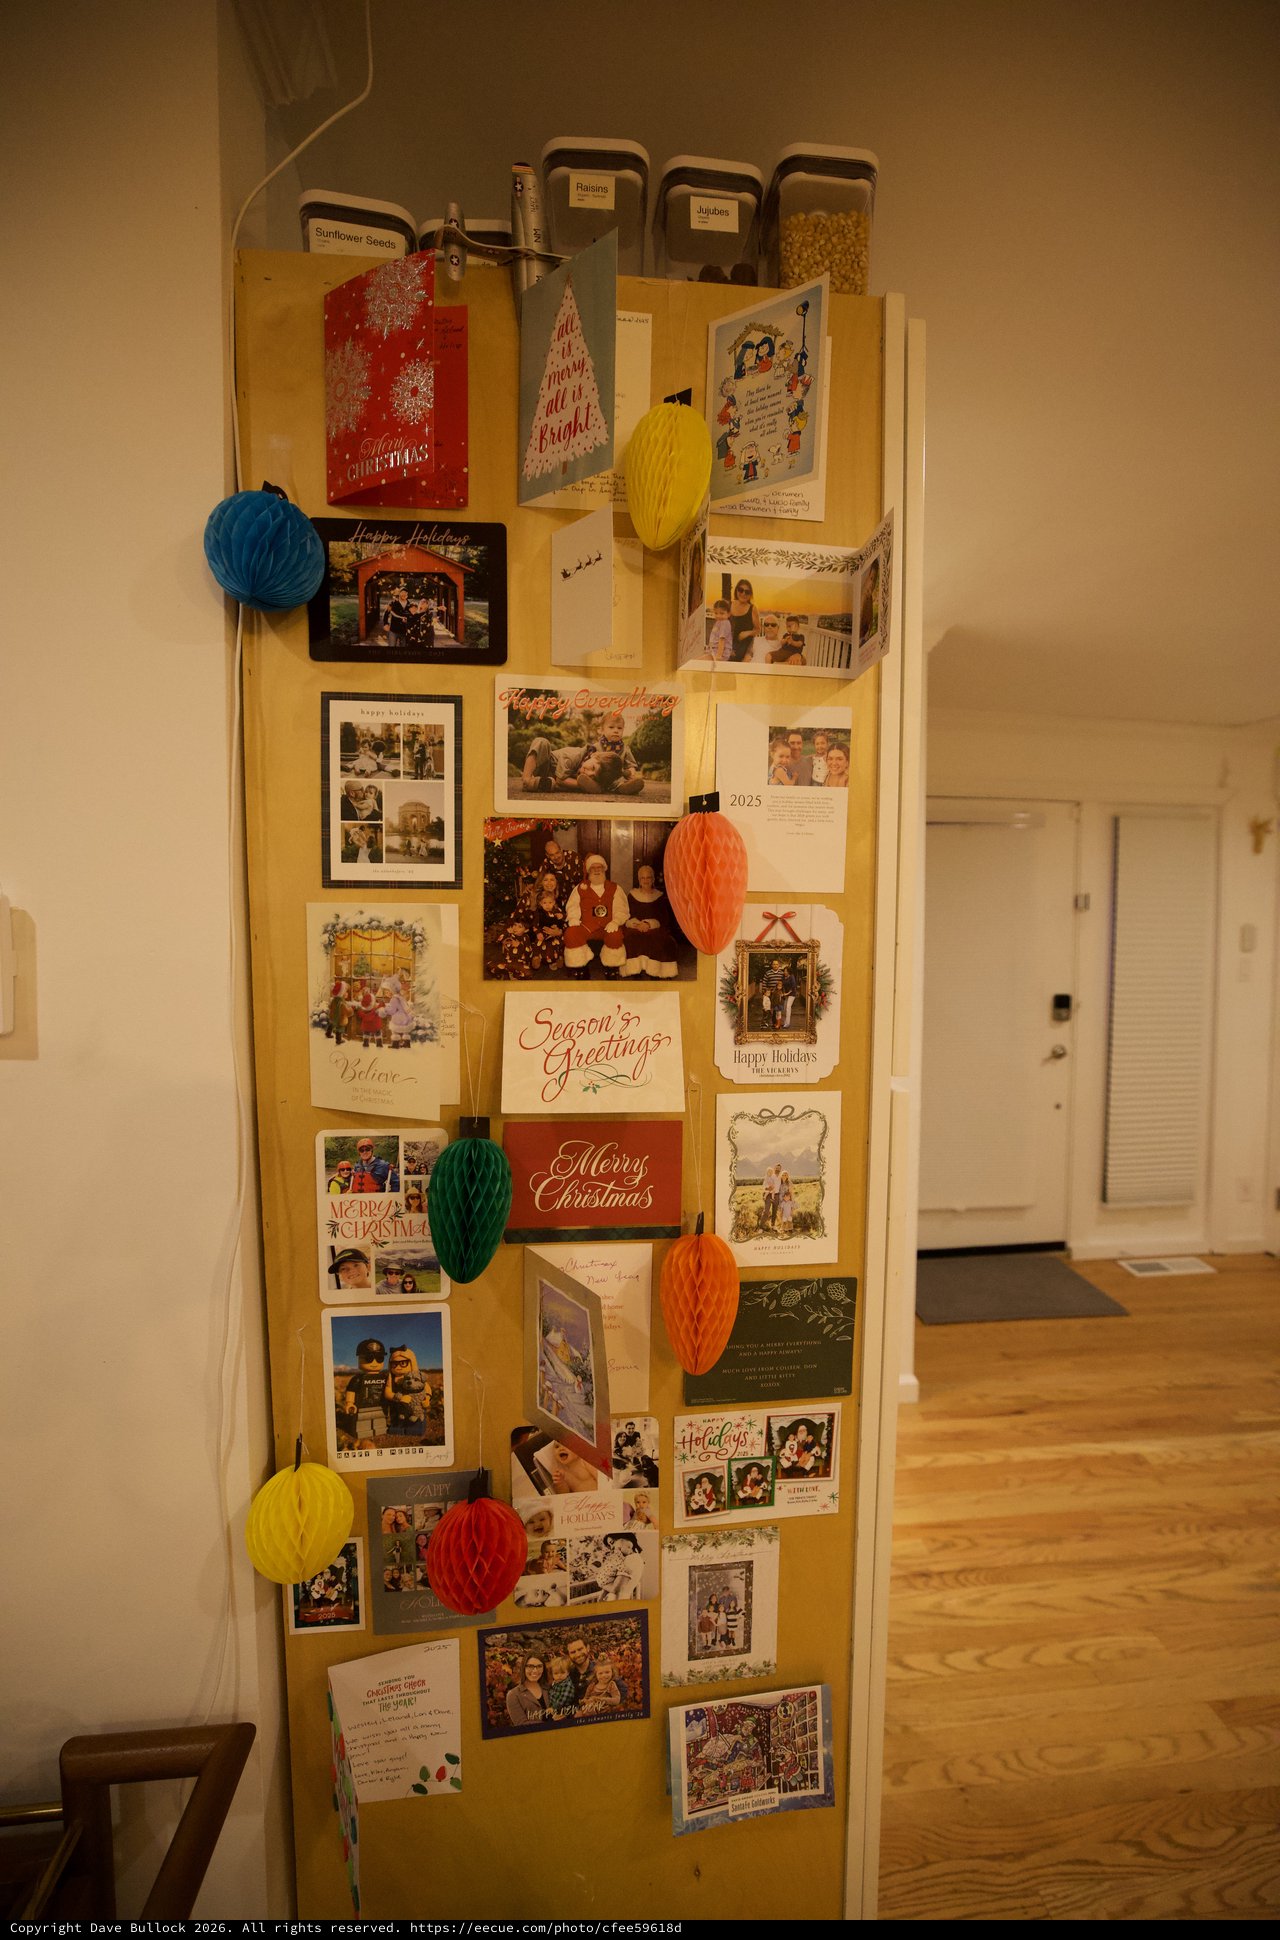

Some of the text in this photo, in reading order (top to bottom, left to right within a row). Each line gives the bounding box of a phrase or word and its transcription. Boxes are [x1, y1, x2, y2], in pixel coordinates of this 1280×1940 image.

[576, 182, 609, 194] Raisins
[696, 205, 730, 217] Jujubes
[315, 228, 396, 250] Sunflower Seeds
[557, 314, 576, 341] all
[561, 340, 572, 360] is
[548, 357, 586, 390] merry
[546, 383, 584, 418] all is
[539, 402, 591, 454] Bright
[359, 432, 417, 460] Merry
[347, 444, 429, 482] CHRISTMAS
[348, 521, 470, 550] Happy Holidays
[360, 708, 425, 717] happy holidays
[498, 686, 681, 720] Happy Everything
[730, 794, 762, 807] 2025
[519, 1004, 640, 1050] Season's
[329, 1050, 418, 1084] Believe
[541, 1032, 672, 1103] Greetings
[733, 1048, 818, 1068] Happy Holidays
[550, 1139, 650, 1186] Merry
[529, 1171, 654, 1212] Christmas
[331, 1199, 393, 1220] MERRY
[340, 1219, 432, 1241] CHRISTMA
[703, 1416, 725, 1424] HAPPY
[677, 1421, 749, 1462] Holidays
[405, 1483, 451, 1499] HAPPY
[563, 1495, 616, 1512] Happy
[560, 1511, 616, 1525] HOLIDAYS
[366, 1684, 402, 1699] CHRISTMAS
[378, 1677, 402, 1686] SENDING
[377, 1695, 394, 1703] LASTS
[395, 1688, 431, 1699] THROUGHOUT
[378, 1702, 392, 1713] THE
